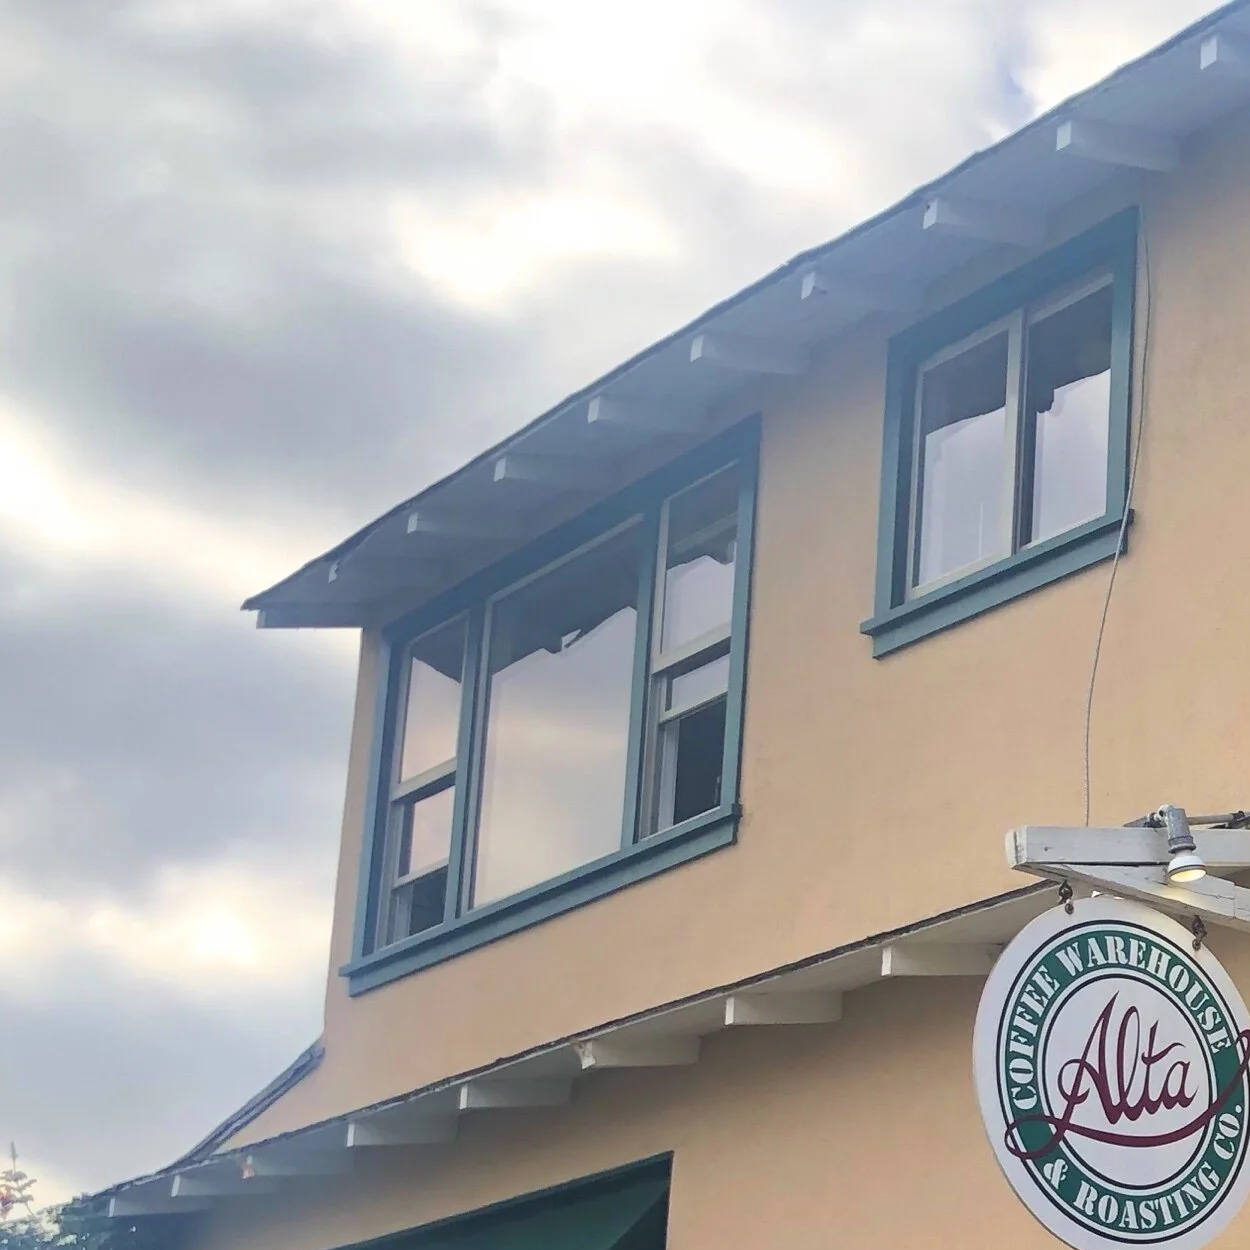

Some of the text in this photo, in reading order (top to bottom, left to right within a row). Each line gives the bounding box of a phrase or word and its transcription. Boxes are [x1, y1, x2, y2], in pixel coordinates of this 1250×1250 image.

[1008, 935, 1233, 1111] COFFEE WAREHOUSE
[1055, 990, 1203, 1141] Alta
[1042, 1103, 1244, 1230] & ROASTING CO.
